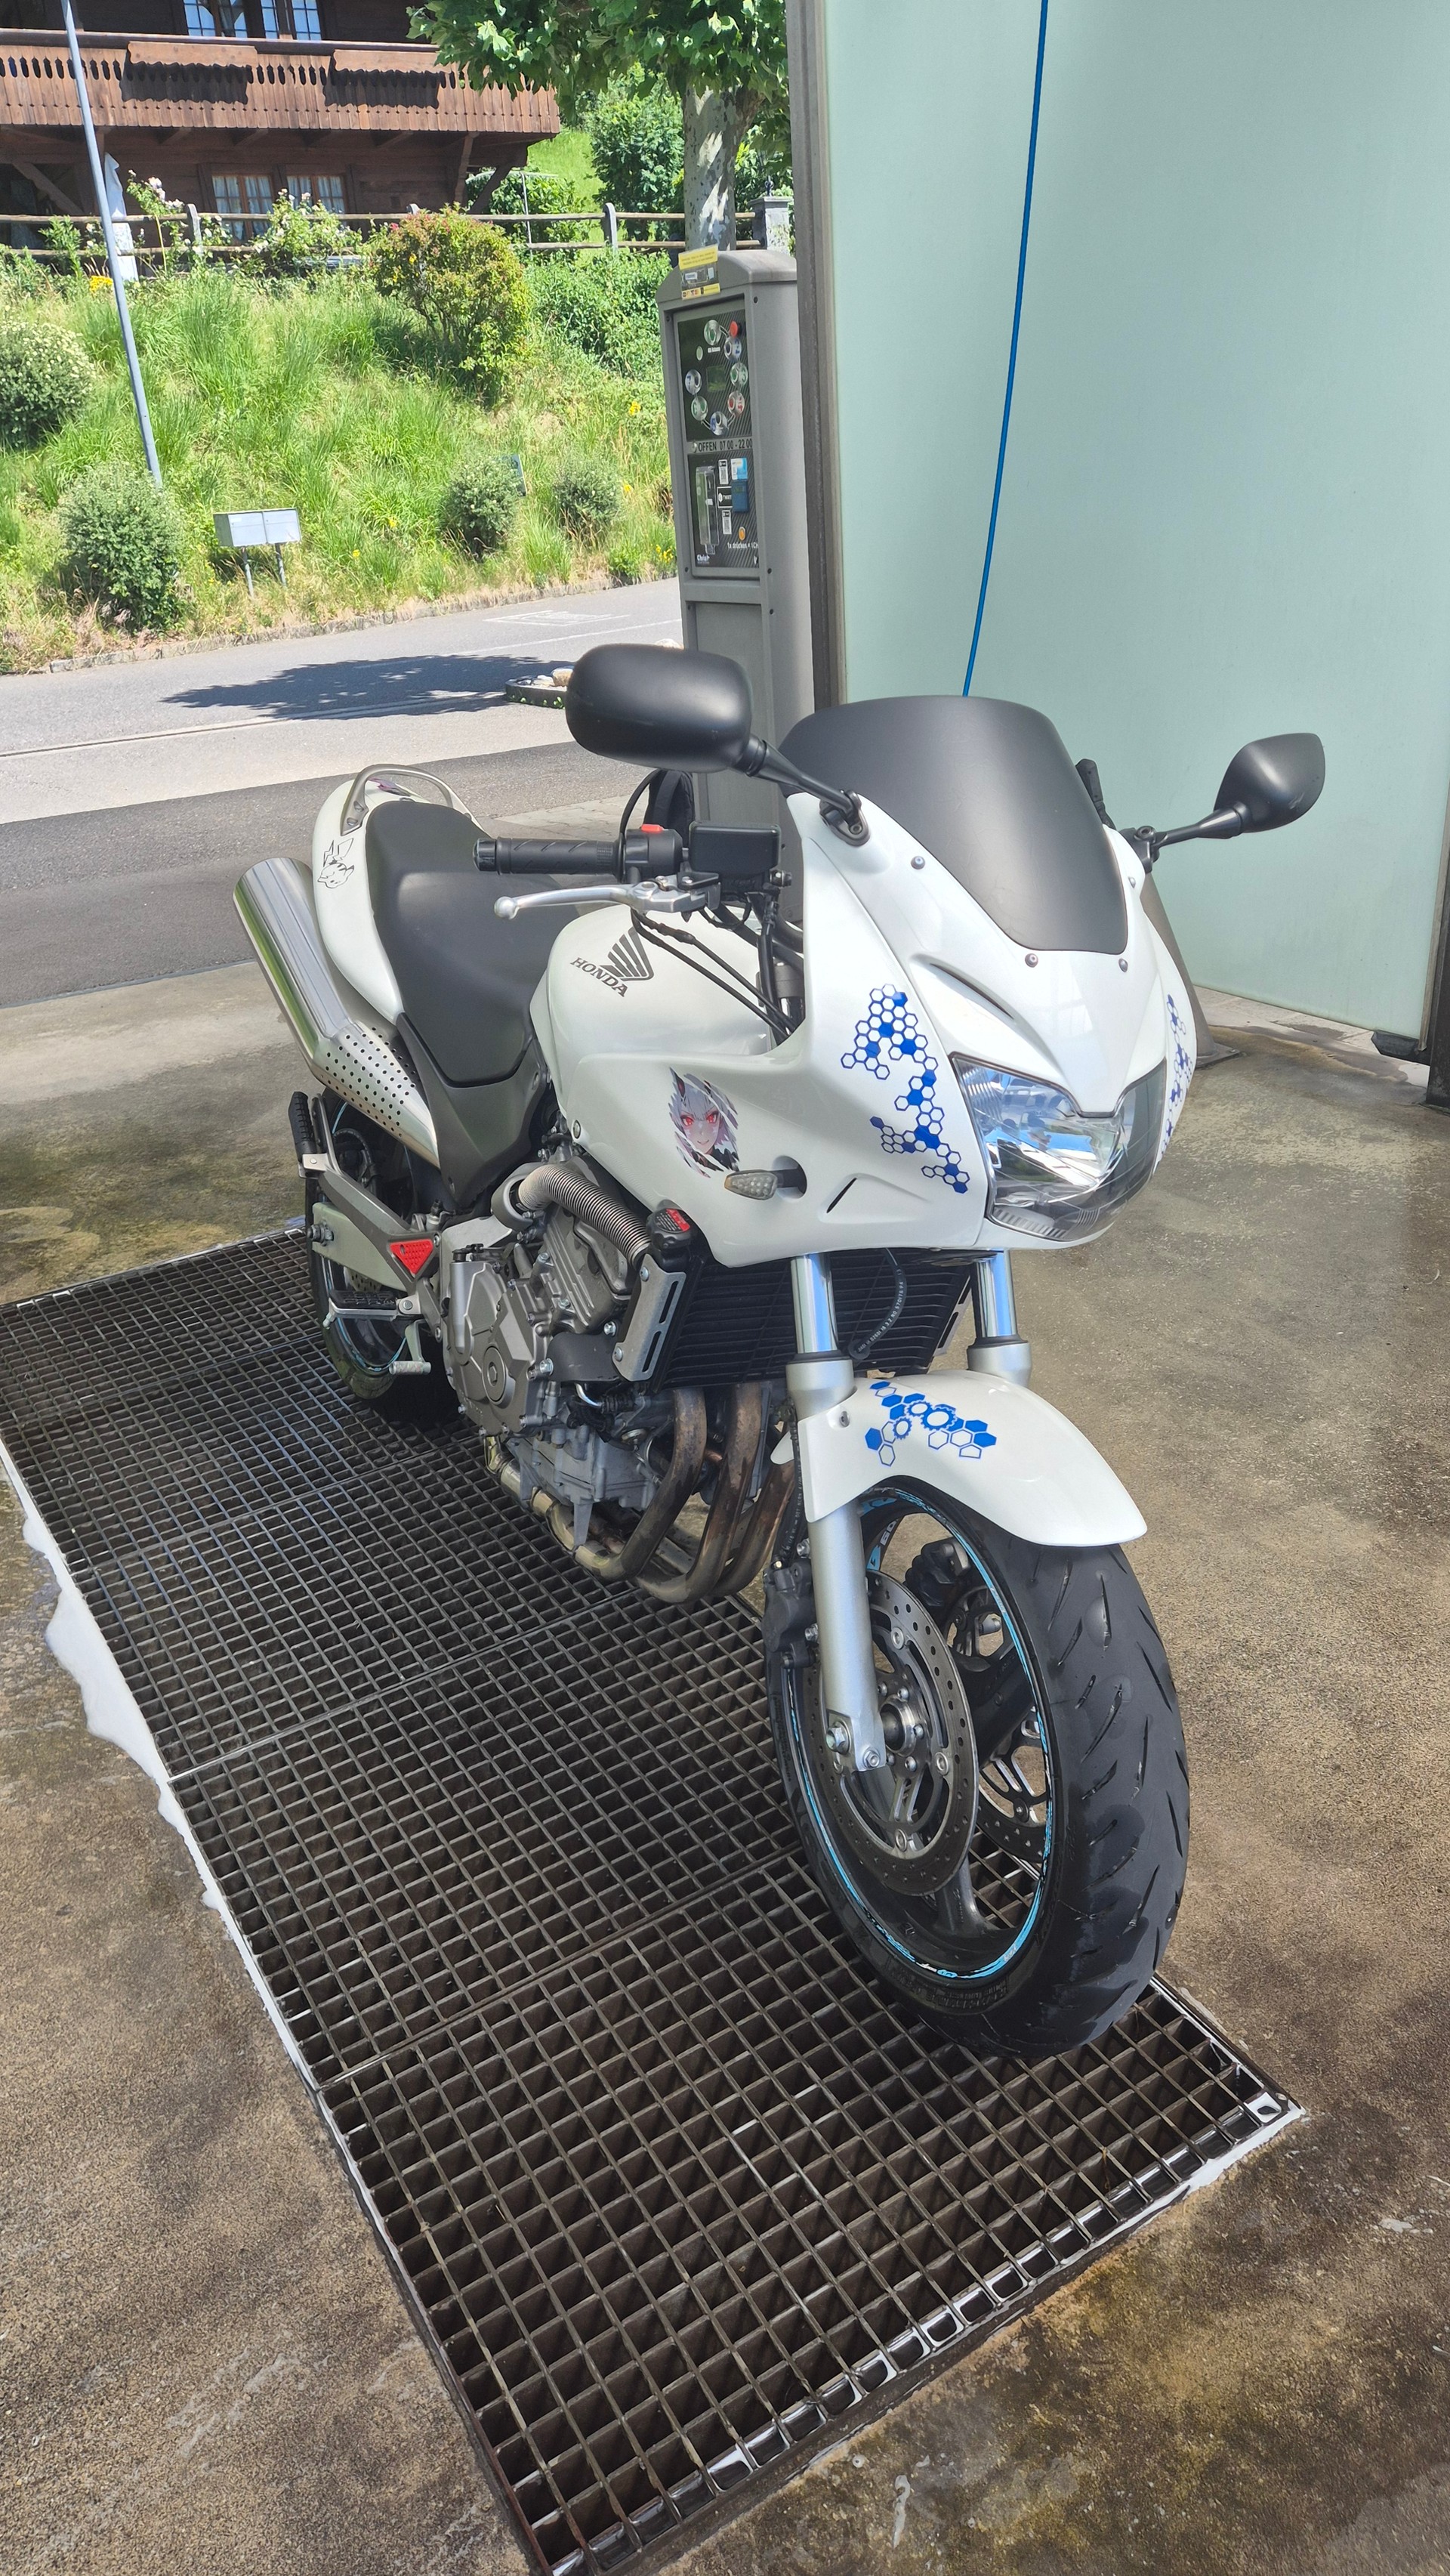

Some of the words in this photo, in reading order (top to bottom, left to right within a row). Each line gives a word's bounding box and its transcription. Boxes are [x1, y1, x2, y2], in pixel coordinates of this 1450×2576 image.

[699, 441, 717, 452] OFFEN
[720, 440, 725, 450] 07
[727, 440, 733, 449] 00
[739, 439, 745, 449] 22
[746, 438, 752, 448] 00
[570, 957, 628, 997] HONDA
